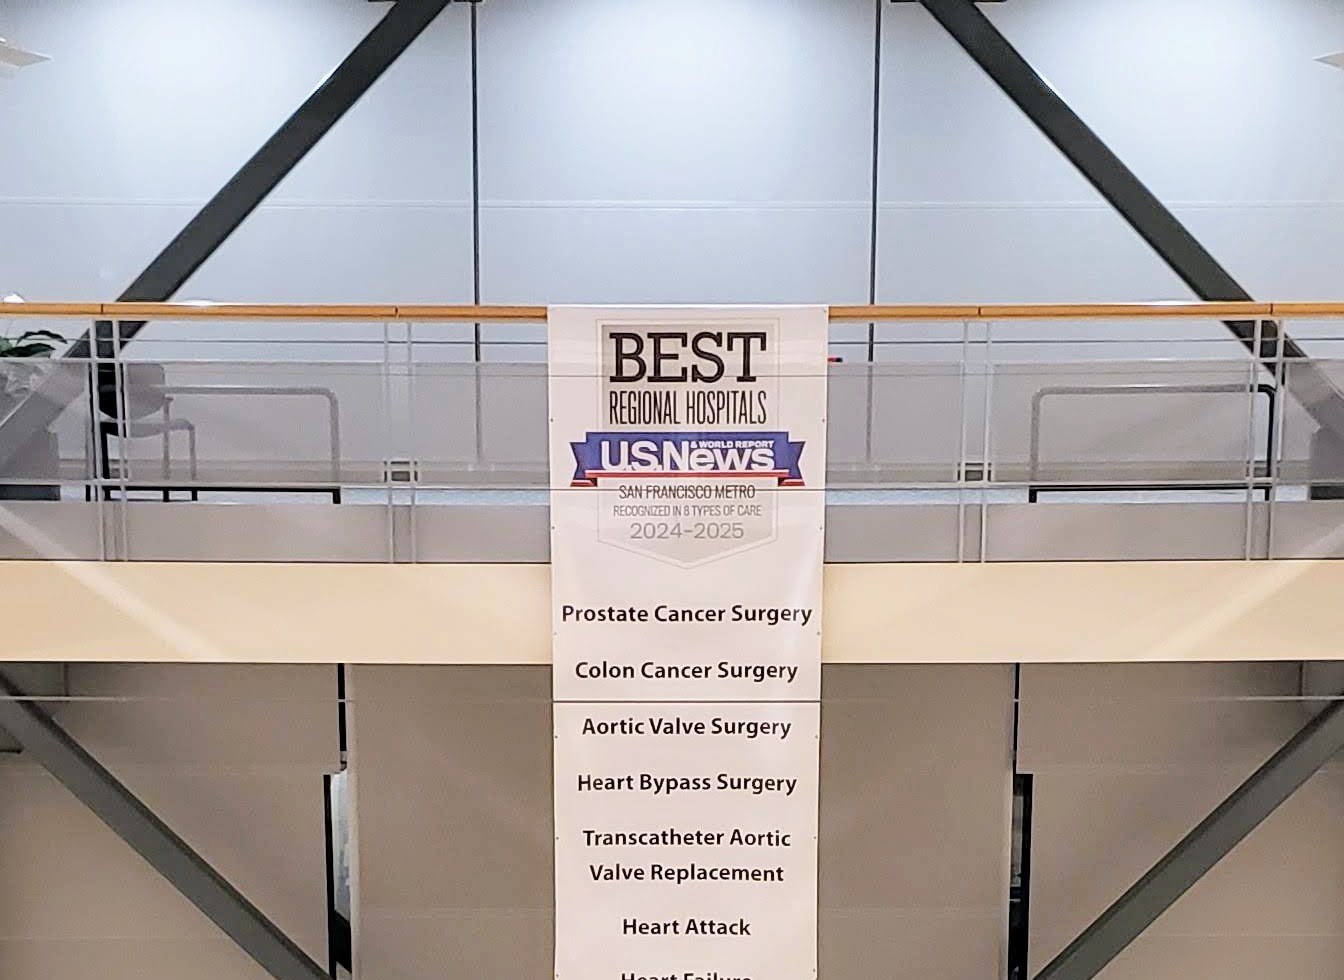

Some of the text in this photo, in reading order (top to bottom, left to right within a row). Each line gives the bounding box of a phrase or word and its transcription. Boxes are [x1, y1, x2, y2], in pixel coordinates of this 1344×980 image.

[609, 331, 767, 383] BEST
[609, 390, 767, 424] REGIONAL HOSPITALS
[699, 440, 733, 449] WORLD
[735, 440, 775, 448] REPORT
[618, 485, 756, 499] SAN FRANCISCO METRO
[613, 505, 670, 517] RECOGNIZED
[672, 505, 682, 517] IN
[692, 505, 721, 517] TYPES
[722, 505, 736, 517] OF
[737, 505, 763, 517] CARE
[630, 522, 745, 540] 2024-2025
[562, 604, 813, 627] Prostate Cancer Surgery
[575, 660, 798, 684] Colon Cancer Surgery
[582, 717, 792, 740] Aortic Valve Surgery
[578, 773, 797, 797] Heart Bypass Surgery
[582, 828, 791, 847] Transcatheter Aortic
[589, 863, 784, 885] Valve Replacement
[623, 918, 751, 936] Heart Attack
